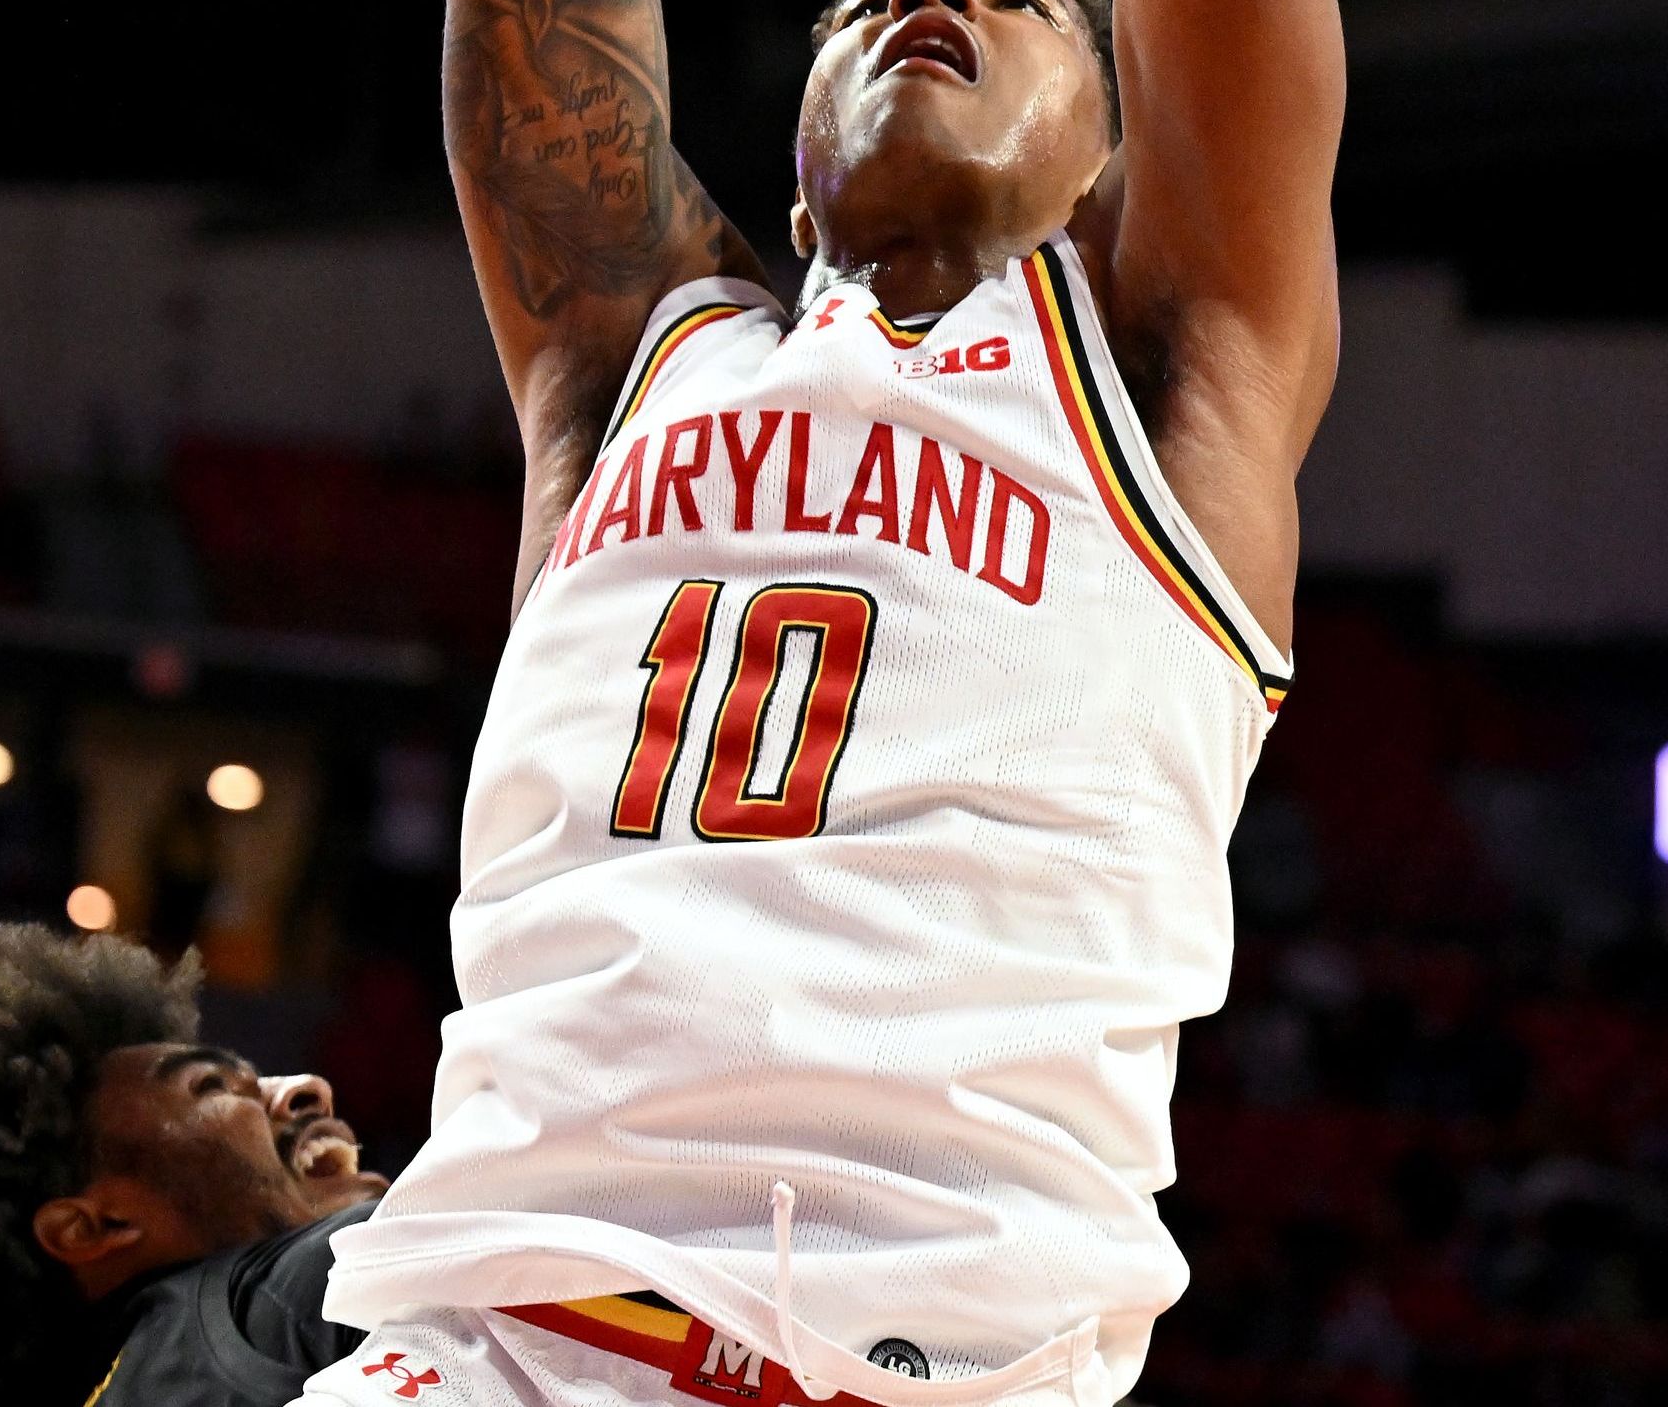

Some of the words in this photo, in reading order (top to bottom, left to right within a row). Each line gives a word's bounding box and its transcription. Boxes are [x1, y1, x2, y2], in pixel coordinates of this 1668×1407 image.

[532, 410, 1051, 606] MARYLAND
[609, 578, 877, 843] 10
[698, 1328, 766, 1389] M
